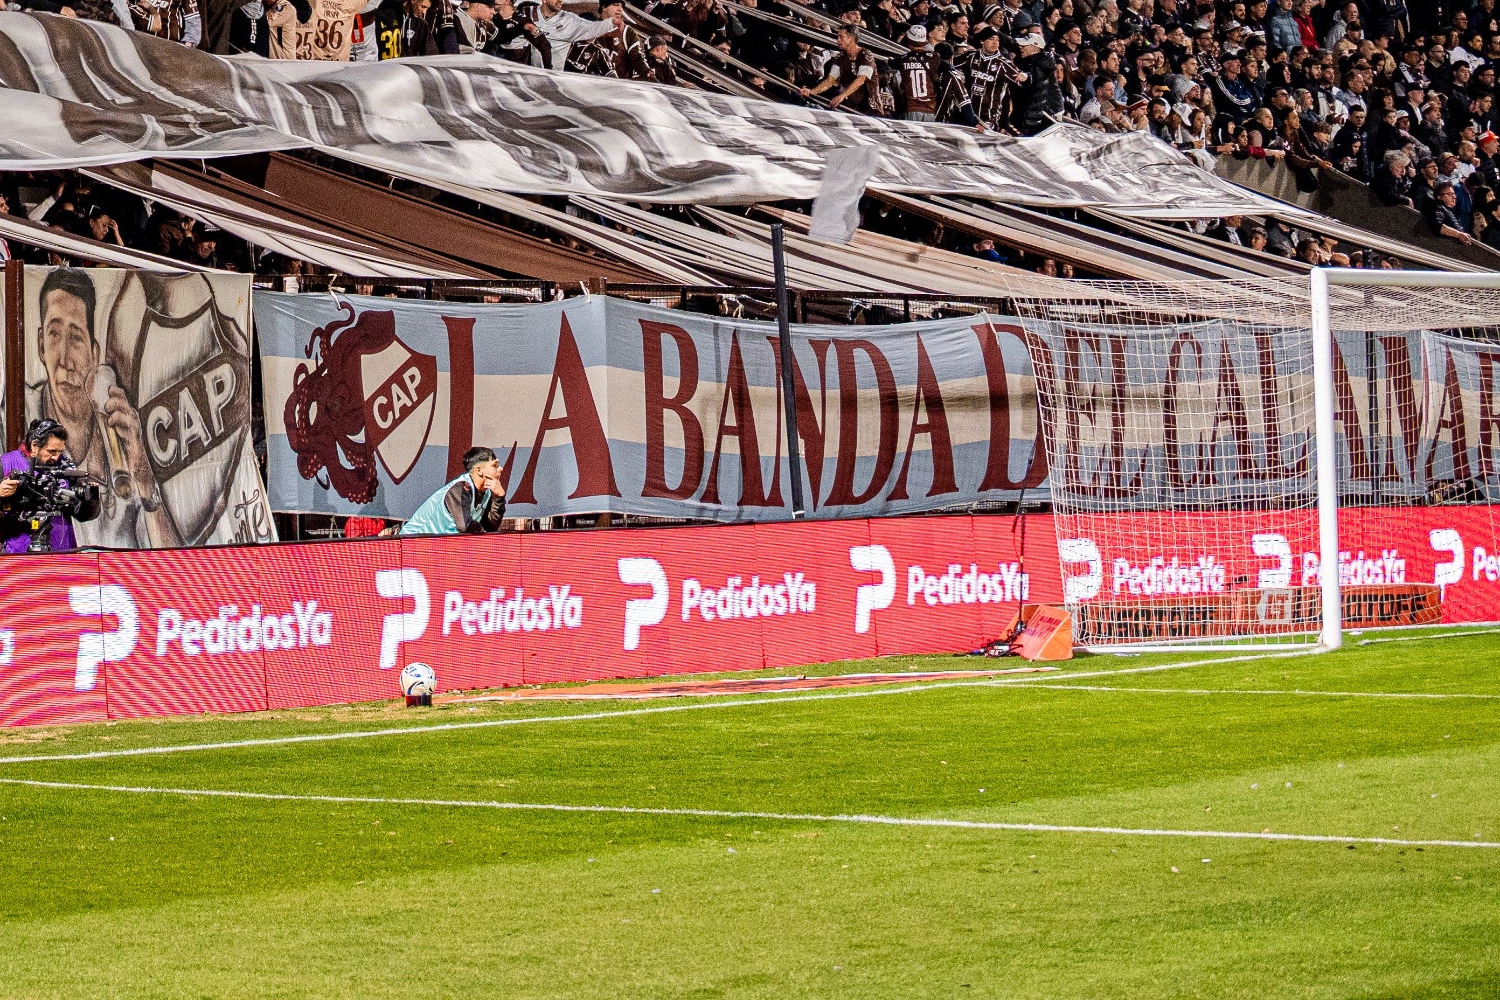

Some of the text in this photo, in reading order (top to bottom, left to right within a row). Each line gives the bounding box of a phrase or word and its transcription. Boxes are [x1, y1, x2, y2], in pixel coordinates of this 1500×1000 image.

[314, 18, 345, 50] 36
[380, 29, 402, 61] 30
[909, 69, 928, 98] 10
[145, 361, 239, 468] CAP
[372, 366, 422, 429] CAP
[440, 310, 622, 505] LA
[637, 318, 960, 512] BANDA
[970, 323, 1150, 499] DEL
[155, 600, 333, 657] PedidosYa
[442, 584, 583, 636] PedidosYa
[682, 571, 817, 619] PedidosYa
[907, 562, 1030, 605] PedidosYa
[1113, 555, 1226, 596] PedidosYa
[1302, 548, 1406, 585] PidosYa
